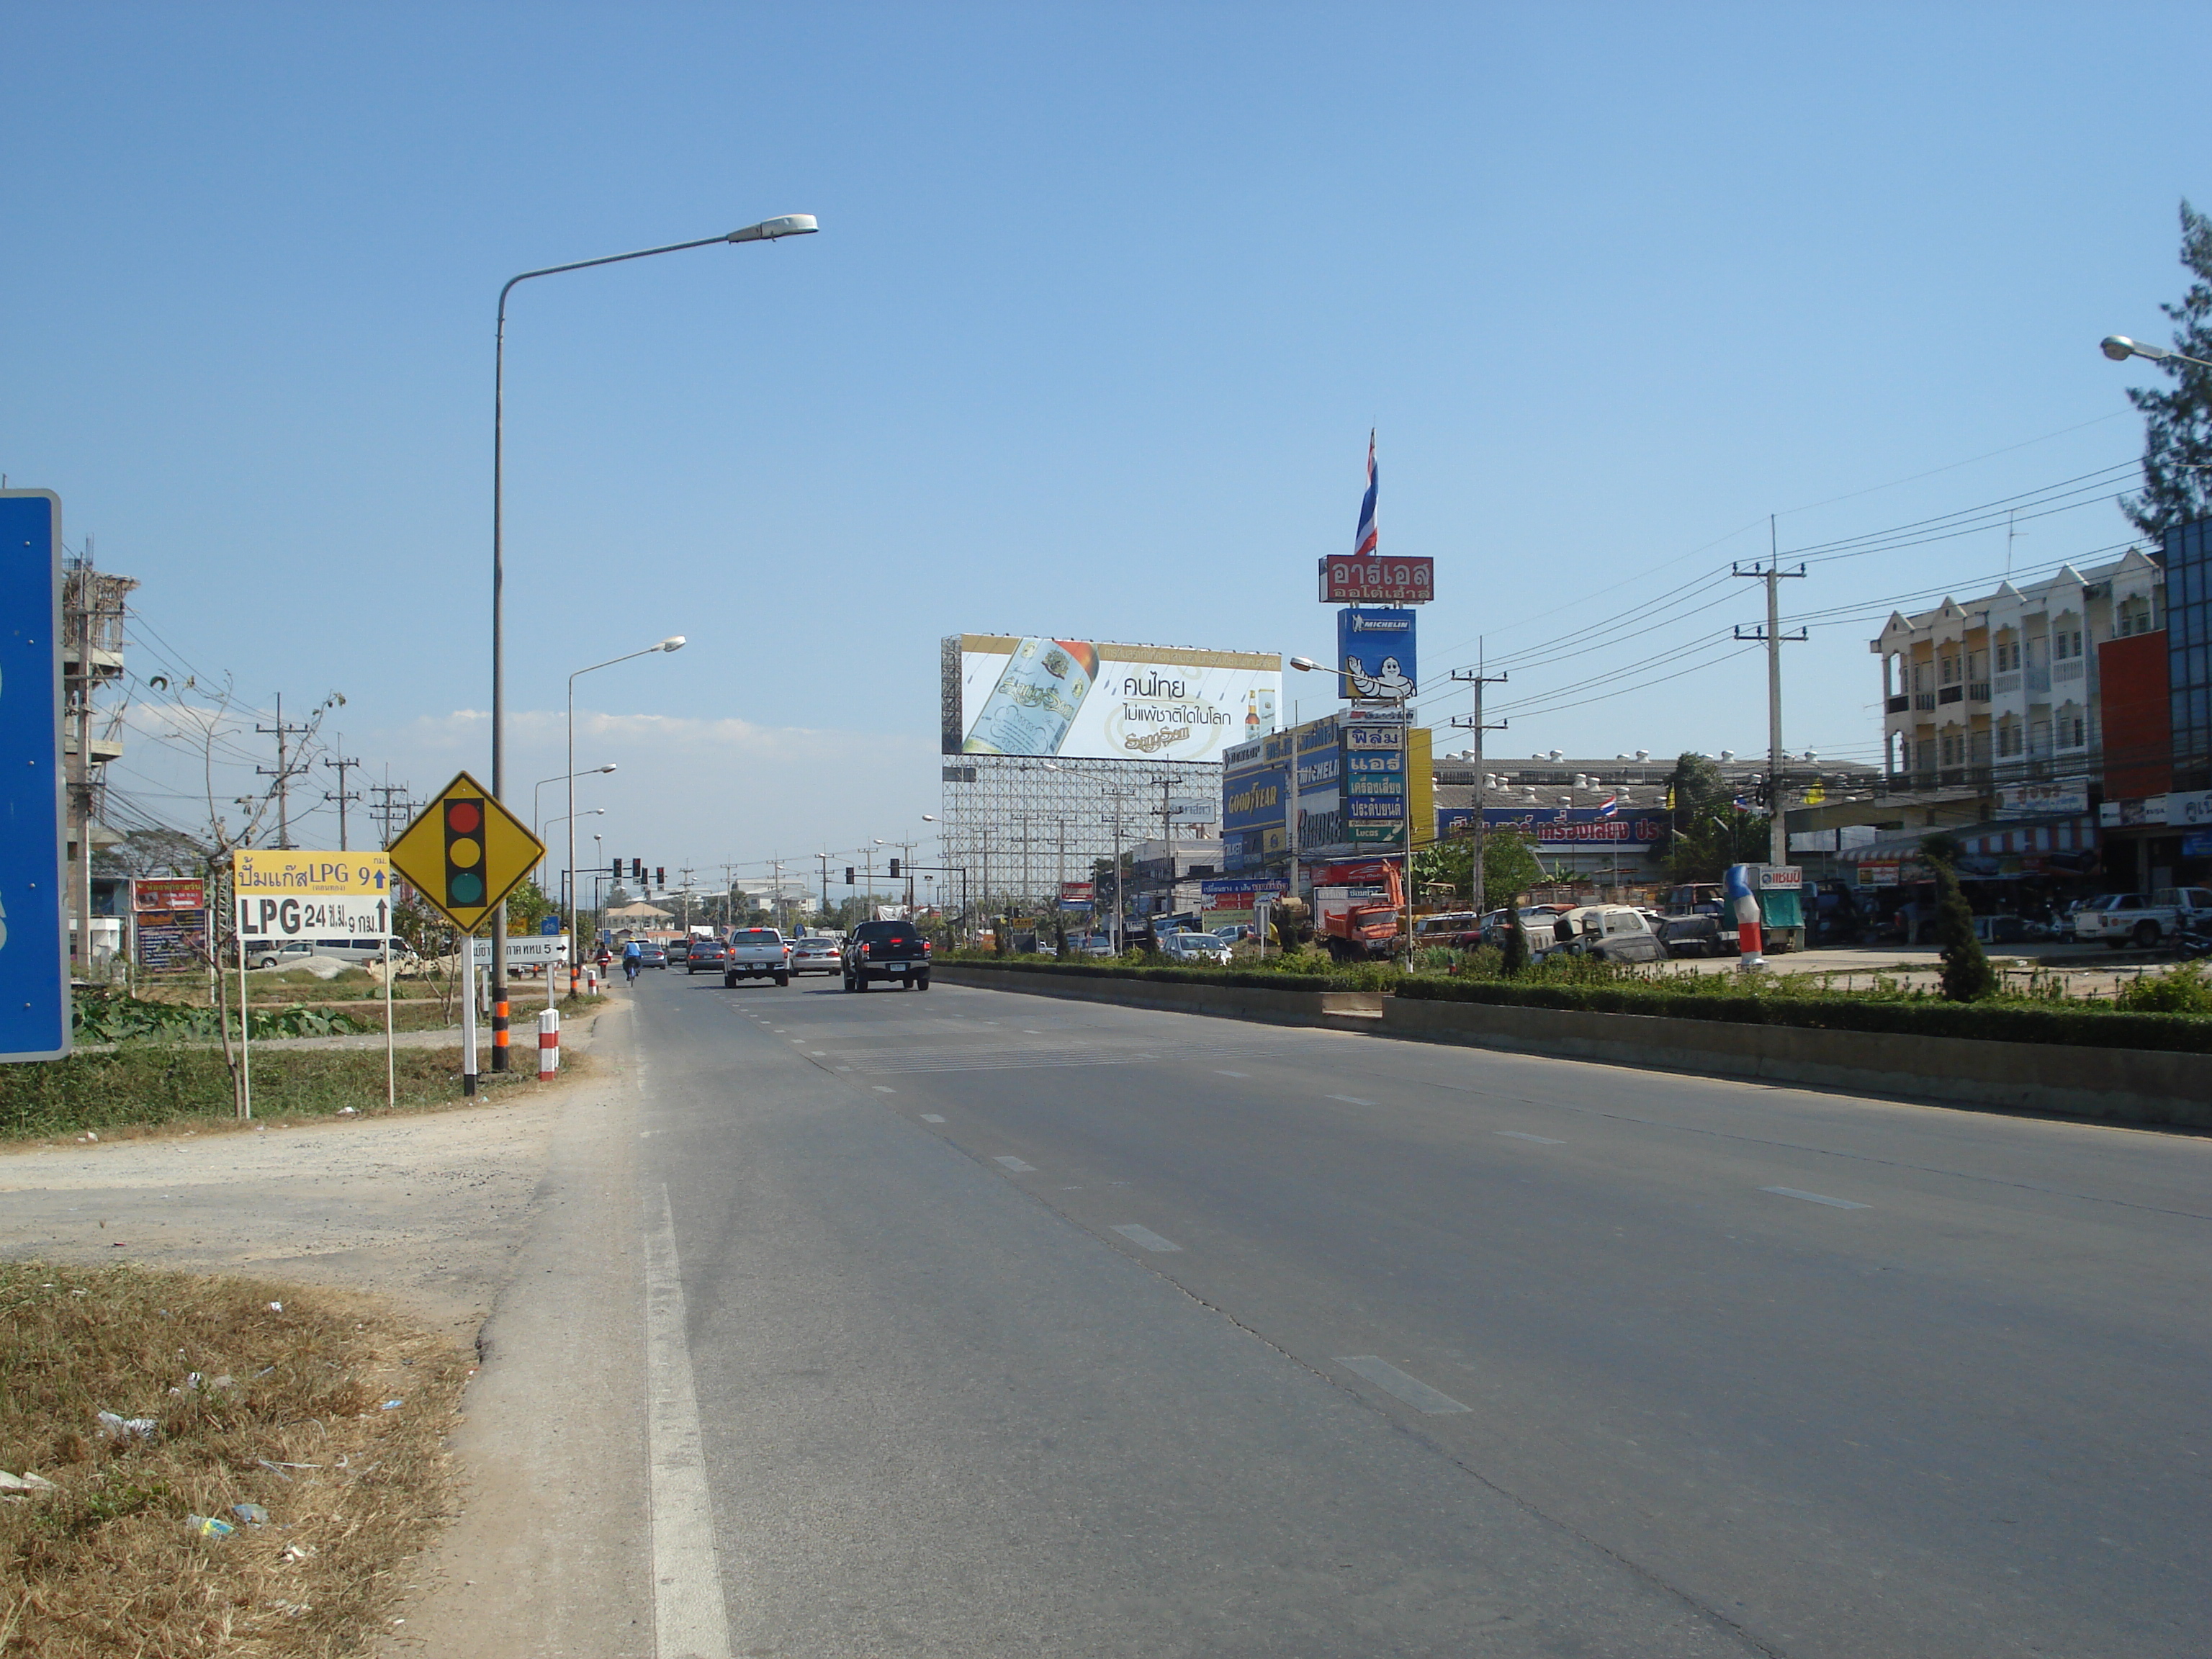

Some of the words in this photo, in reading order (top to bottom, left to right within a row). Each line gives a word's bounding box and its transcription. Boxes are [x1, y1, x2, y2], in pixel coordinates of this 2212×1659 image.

[1332, 557, 1430, 585] อาร์เอส
[1124, 670, 1185, 698] คนไทย
[1123, 701, 1231, 725] ไม่แพ้ชาติใดในโลก
[1352, 729, 1398, 744] ฟิล์ม
[1230, 745, 1260, 764] DUNLOP
[1351, 753, 1401, 770] แอร์
[1351, 775, 1401, 794] เครื่องเสียง
[1351, 797, 1401, 817] ประดับยนต์
[1356, 828, 1379, 837] Lucas
[1537, 809, 1630, 841] เครื่องเสียง
[310, 863, 349, 883] LPG
[359, 867, 370, 886] 9
[241, 899, 301, 935] LPG
[305, 904, 326, 928] 24
[349, 916, 355, 933] 9
[359, 915, 378, 933] กม.
[544, 944, 552, 954] 5
